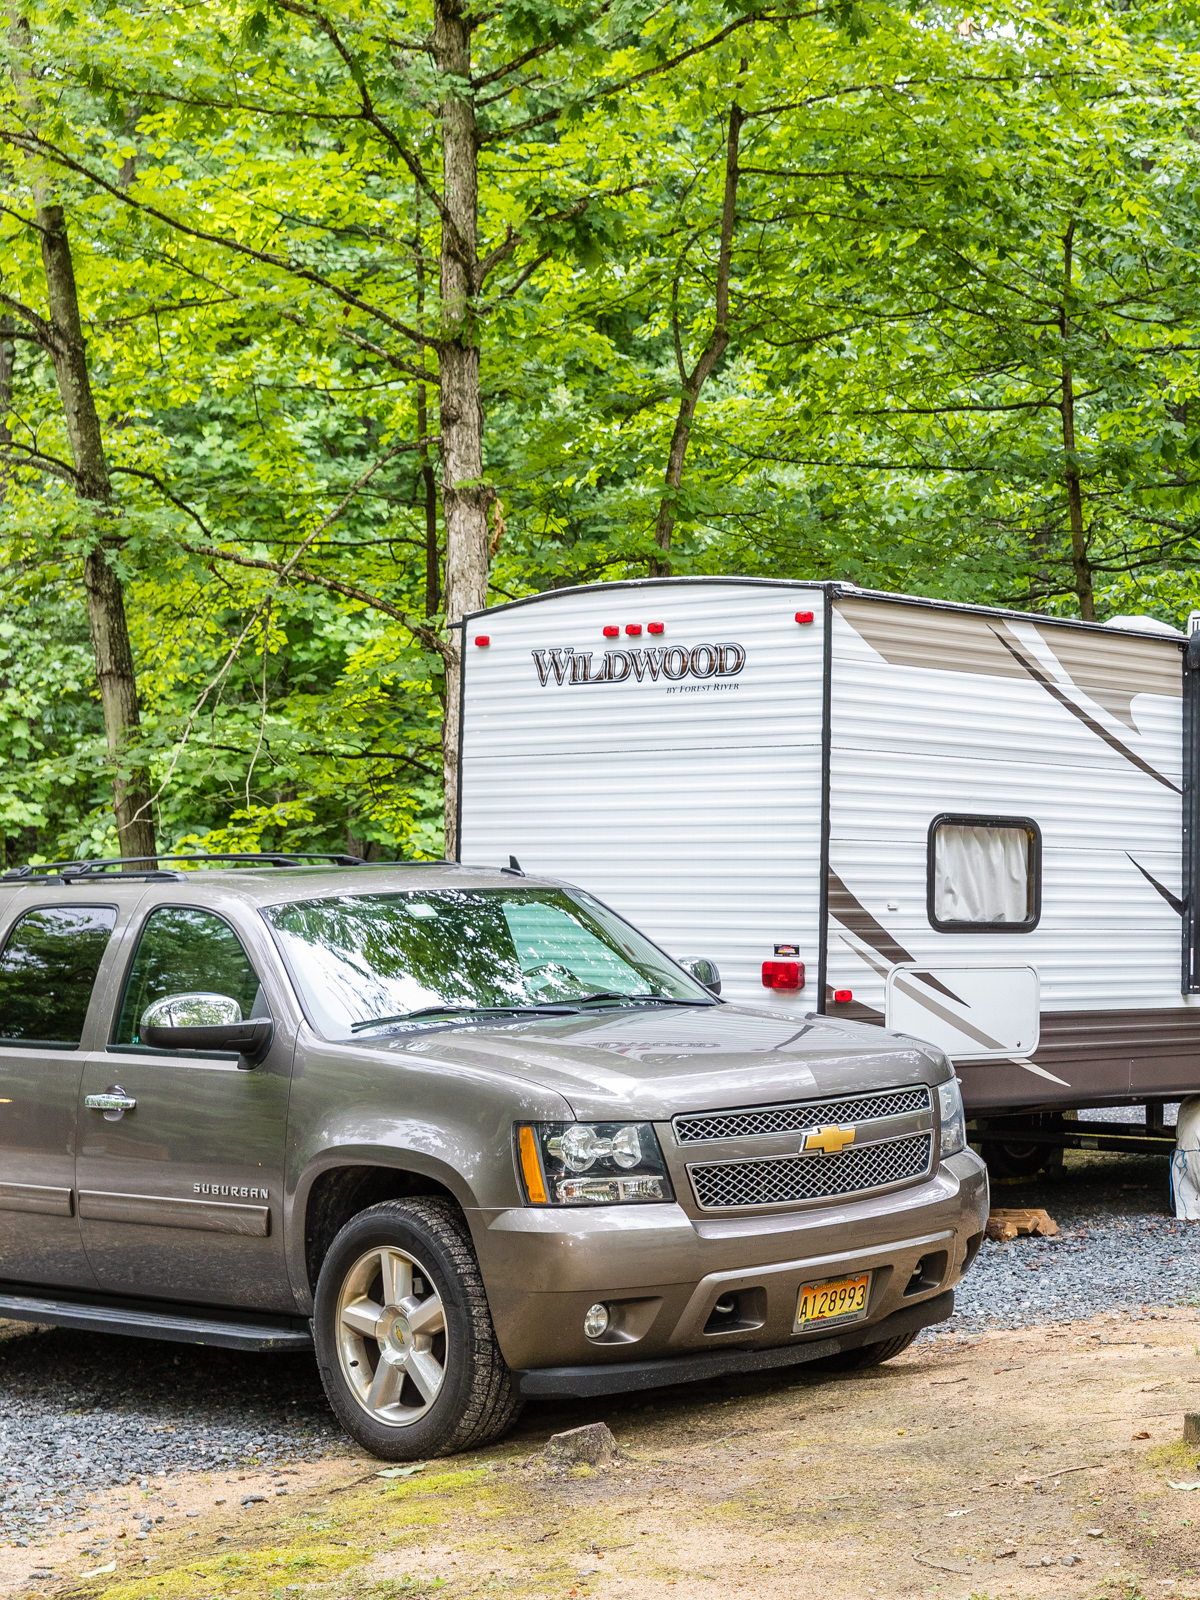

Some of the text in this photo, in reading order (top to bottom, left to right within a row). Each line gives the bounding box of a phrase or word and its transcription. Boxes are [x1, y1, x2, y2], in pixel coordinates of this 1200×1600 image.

[531, 642, 747, 687] WILDWOOD
[666, 683, 740, 694] BY FOREST RIVER
[193, 1182, 269, 1199] SUBURBAN
[799, 1284, 866, 1319] A128993
